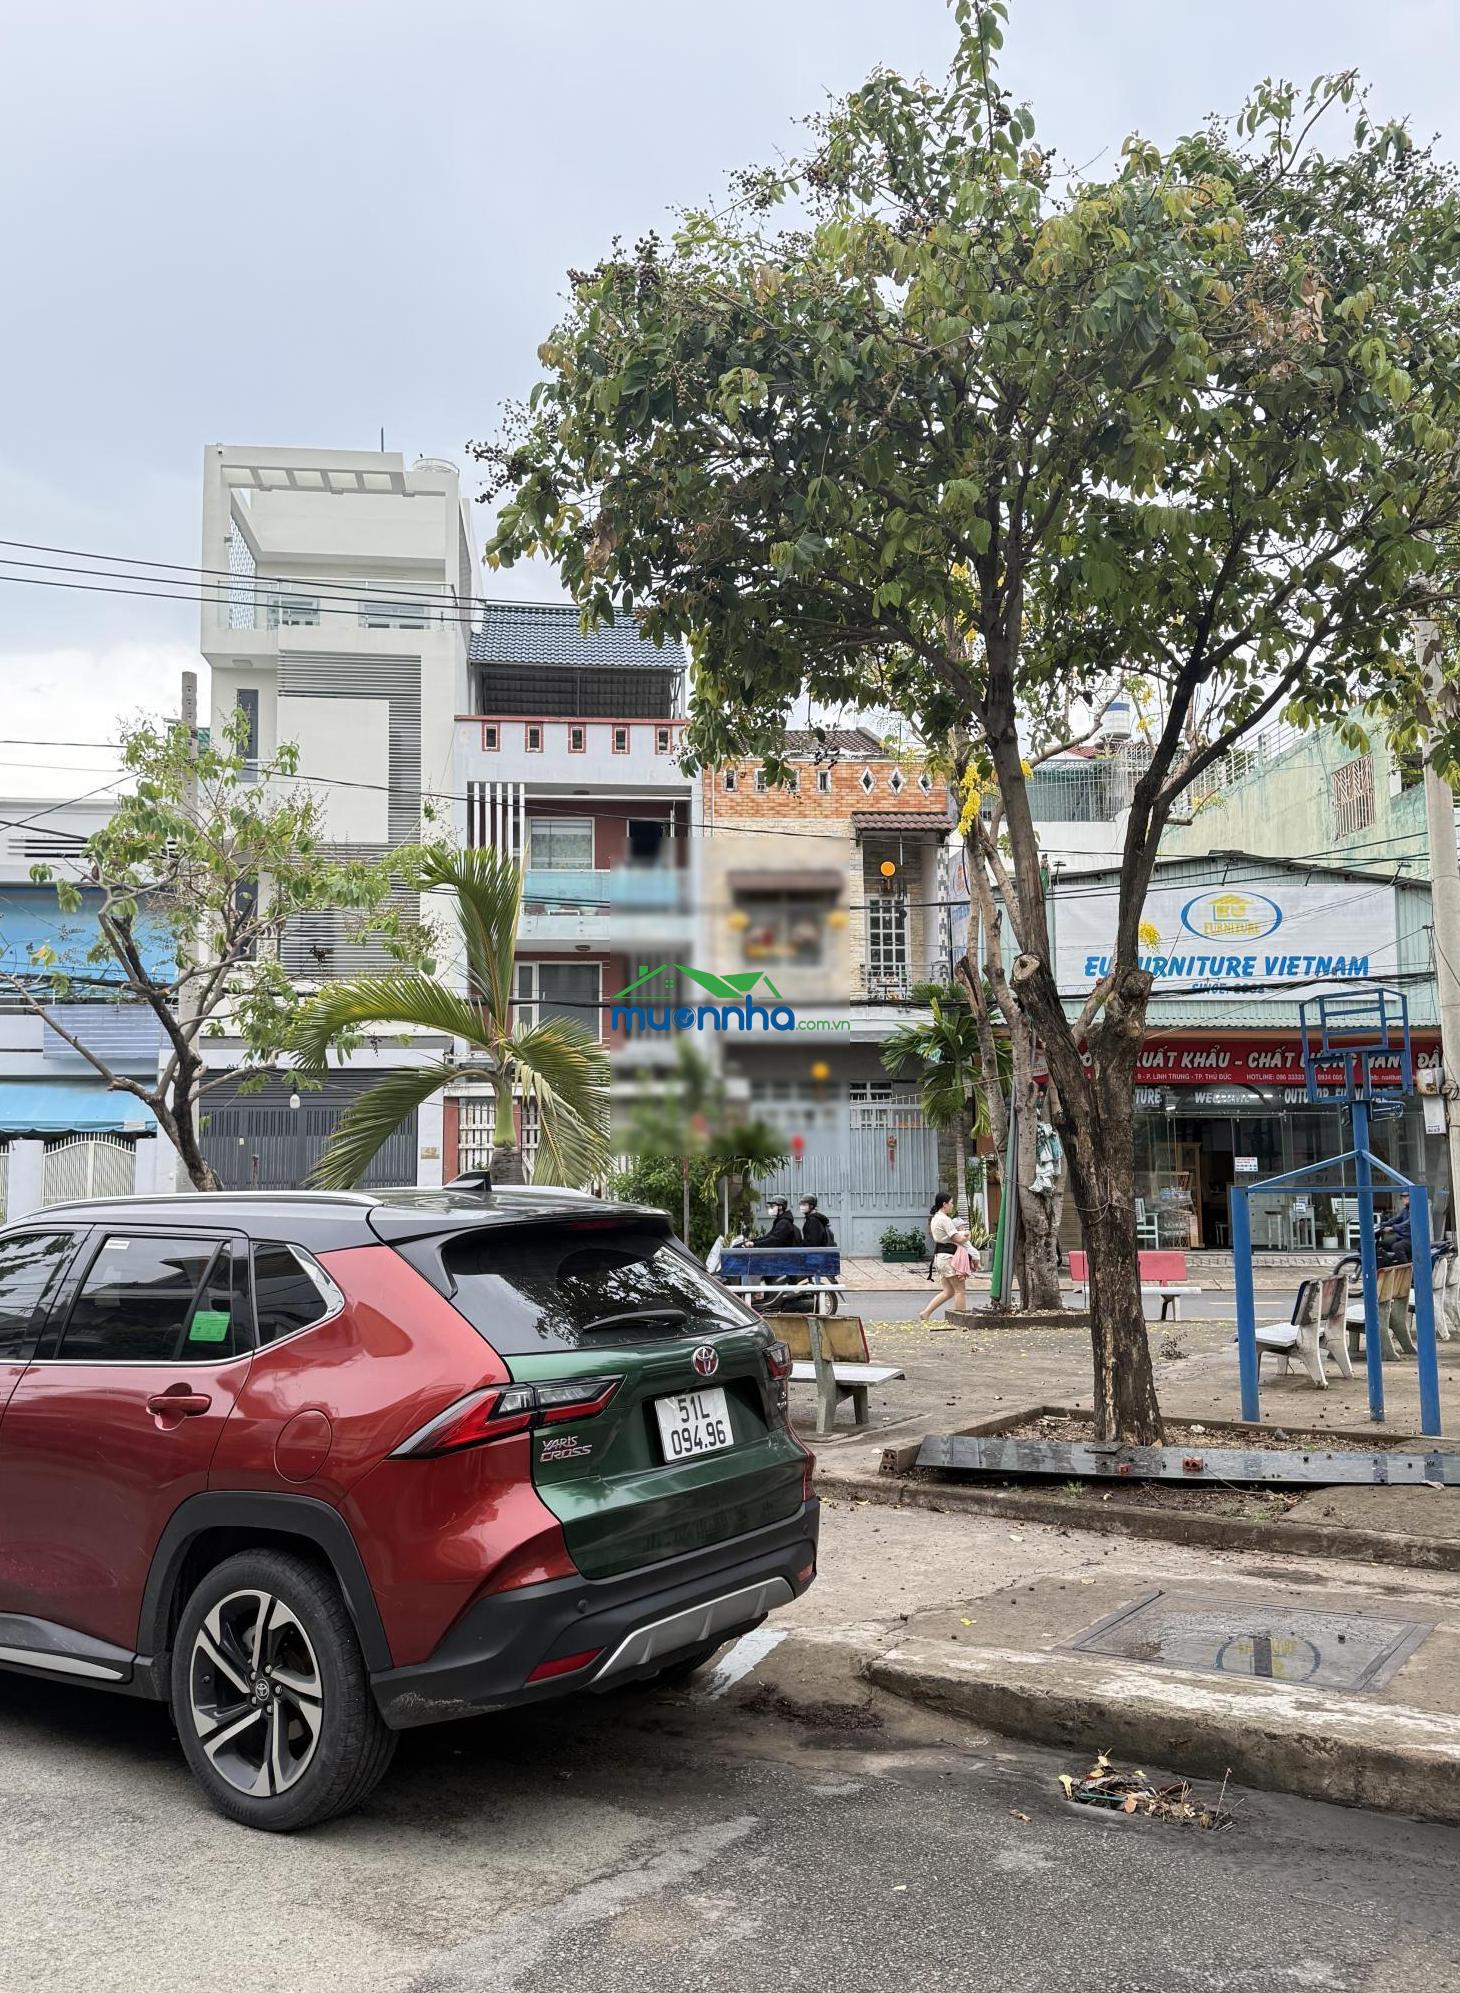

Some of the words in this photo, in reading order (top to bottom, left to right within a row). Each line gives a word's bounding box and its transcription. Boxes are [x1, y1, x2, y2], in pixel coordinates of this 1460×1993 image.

[1204, 922, 1262, 935] FURNITURE
[1137, 955, 1258, 977] URNITURE
[1264, 955, 1370, 977] VIETNAM
[1180, 1044, 1231, 1069] KHẨU
[1247, 1045, 1296, 1069] CHẤT
[1417, 1045, 1445, 1069] ĐẦ
[677, 1394, 710, 1423] 51L
[543, 1436, 578, 1451] YARIS
[671, 1420, 726, 1456] 094.96
[540, 1445, 592, 1462] CROSS
